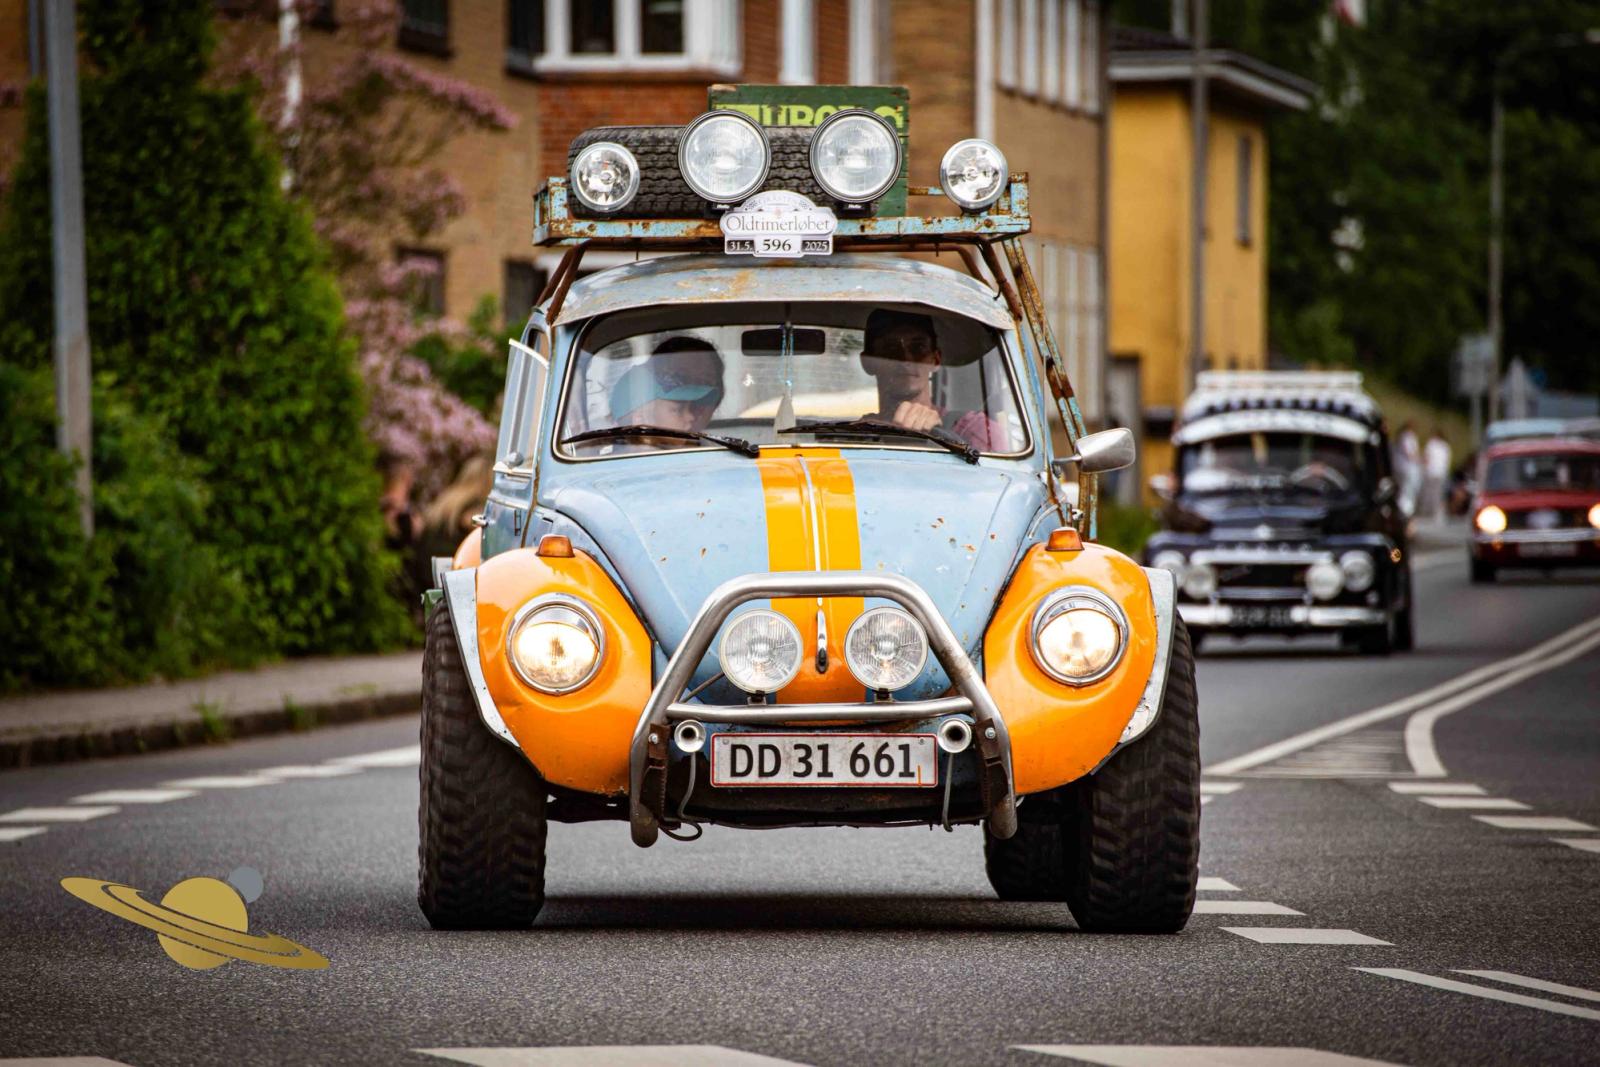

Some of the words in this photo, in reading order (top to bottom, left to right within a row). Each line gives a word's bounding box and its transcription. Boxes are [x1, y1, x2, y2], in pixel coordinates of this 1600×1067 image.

[726, 215, 830, 231] Oldtimerløbet
[763, 239, 791, 251] 596
[805, 241, 828, 251] 2025
[730, 743, 782, 778] DD
[792, 743, 834, 778] 31
[849, 741, 915, 778] 661
